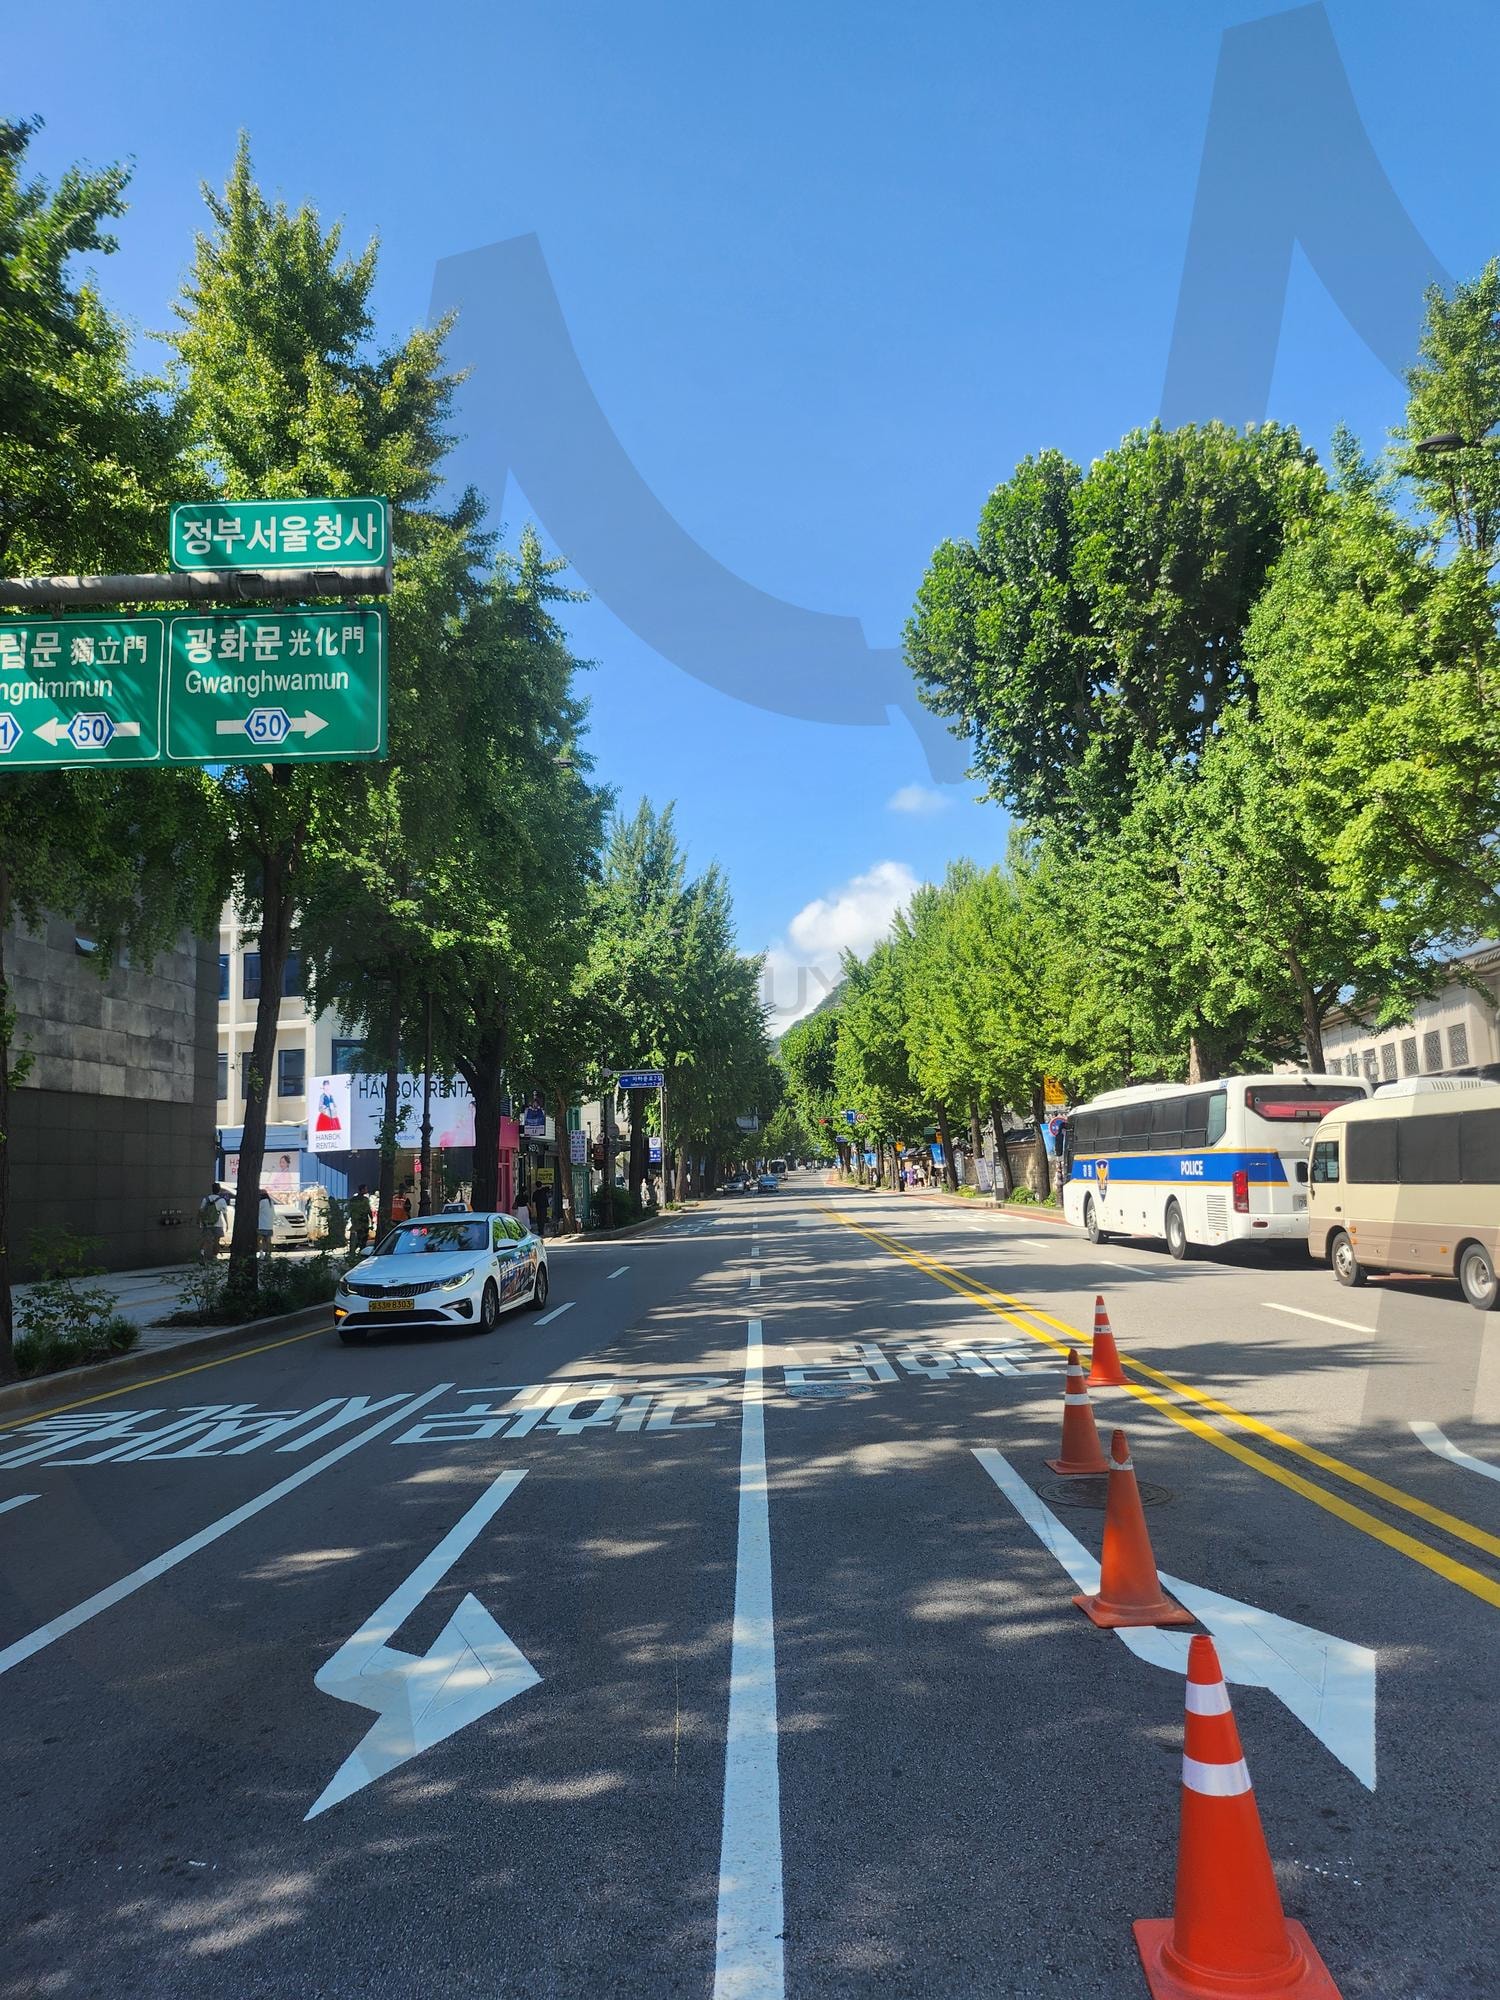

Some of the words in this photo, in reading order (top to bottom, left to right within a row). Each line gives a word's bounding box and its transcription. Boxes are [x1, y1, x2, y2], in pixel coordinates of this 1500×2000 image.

[182, 513, 376, 555] 정부서울청사
[71, 636, 148, 666] 獨立門
[184, 625, 283, 664] 광화문
[288, 626, 365, 657] 光化門
[185, 670, 349, 698] Gwanghwamun
[79, 719, 105, 741] 50
[254, 714, 282, 737] 50
[429, 1081, 473, 1098] RENTA
[315, 1134, 341, 1142] HANBOK
[1180, 1160, 1203, 1175] POLICE
